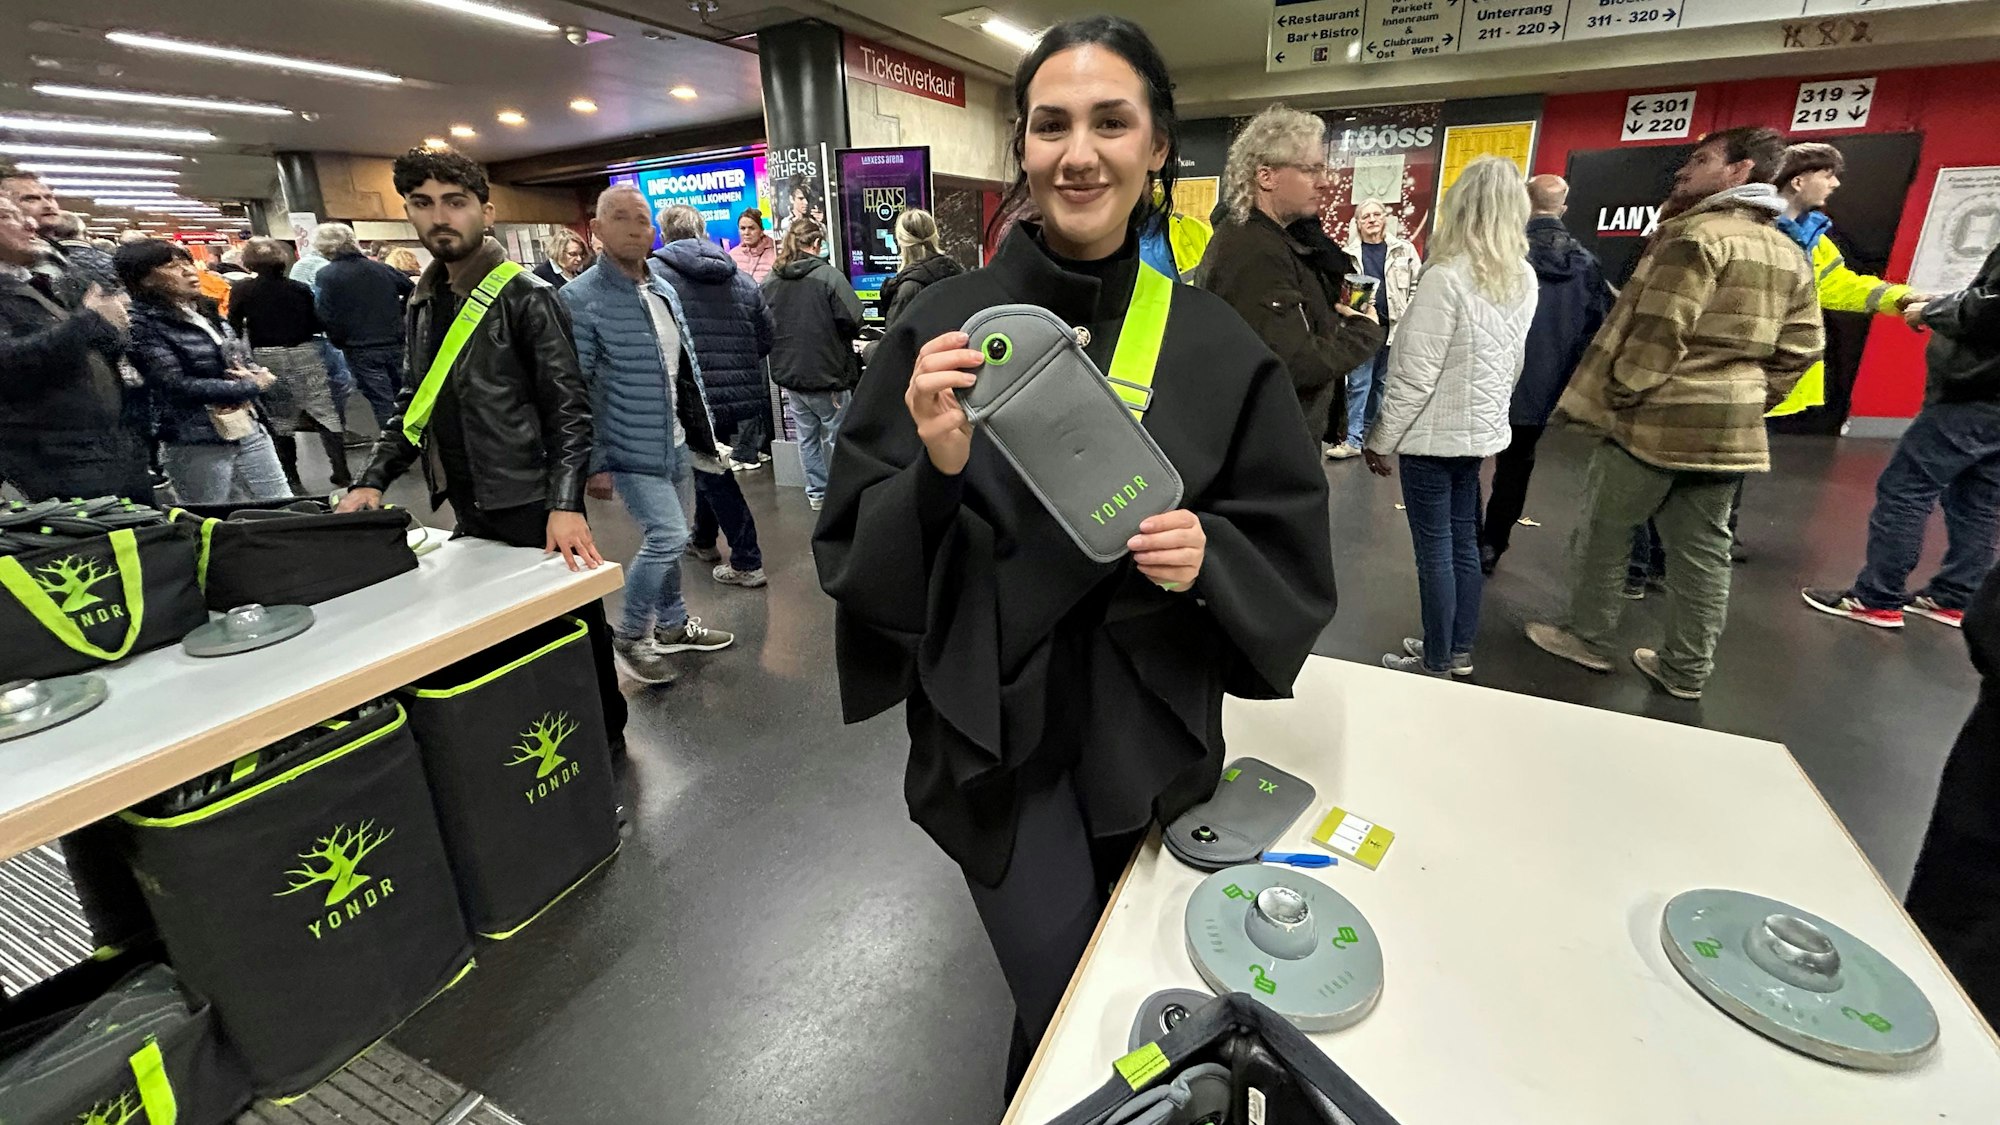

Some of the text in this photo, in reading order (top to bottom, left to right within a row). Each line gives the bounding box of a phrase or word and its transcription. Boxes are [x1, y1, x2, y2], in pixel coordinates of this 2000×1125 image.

[1287, 8, 1360, 25] Restaurant
[1391, 2, 1433, 14] Parkett
[1477, 3, 1552, 21] Unterrang
[1382, 13, 1439, 26] Innenraum
[1587, 15, 1612, 28] 311
[1629, 9, 1659, 23] 320
[1478, 27, 1502, 40] 211
[1516, 22, 1545, 35] 220
[1383, 35, 1434, 48] Clubraum
[1376, 45, 1440, 59] Ost West
[860, 45, 955, 99] Ticketverkauf
[1801, 87, 1844, 103] 319
[1651, 98, 1689, 114] 301
[1796, 108, 1838, 123] 219
[1648, 118, 1686, 132] 220
[648, 169, 746, 196] INFOCOUNTER
[654, 191, 742, 209] HERZLICH WILLKOMMEN
[461, 273, 507, 323] YONDR
[1091, 475, 1148, 525] YONDR
[70, 604, 124, 627] NDR
[525, 761, 580, 804] YONDR
[1259, 778, 1279, 794] XL
[308, 878, 394, 939] YONDR
